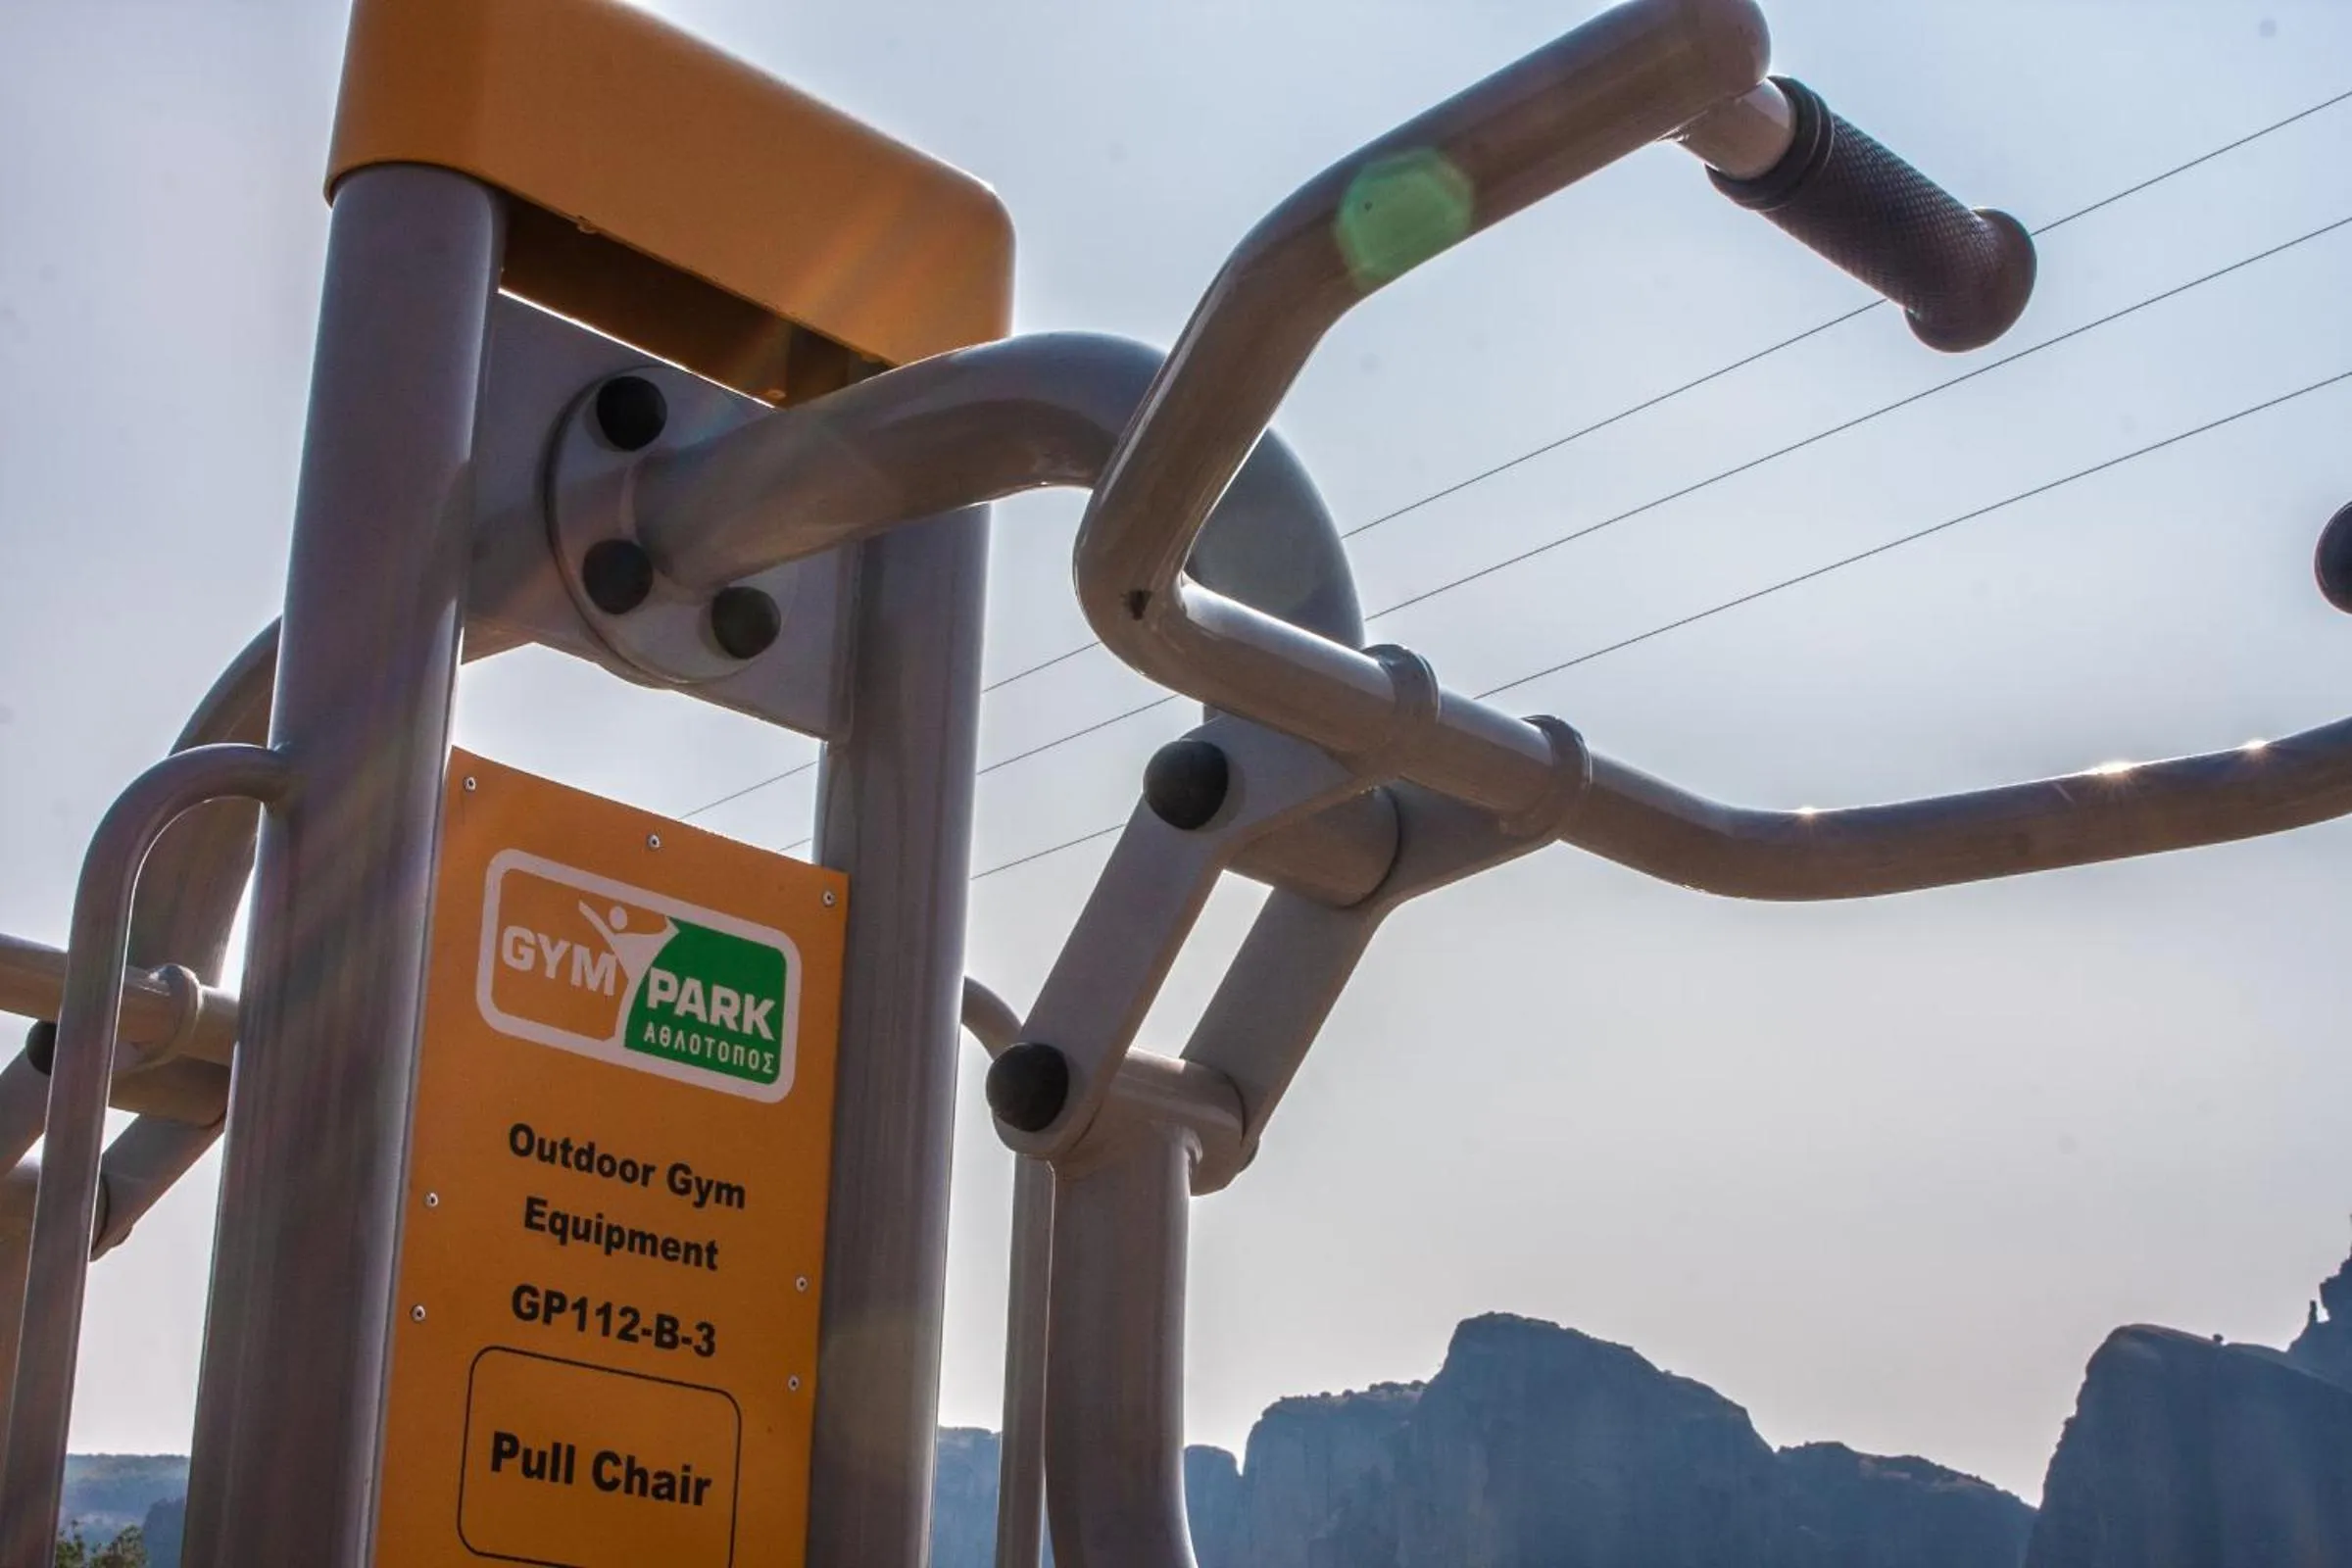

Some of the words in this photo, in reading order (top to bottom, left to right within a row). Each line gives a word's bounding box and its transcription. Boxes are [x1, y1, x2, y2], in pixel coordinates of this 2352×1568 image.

[502, 925, 617, 997] GYM
[647, 966, 775, 1041] PARK
[644, 1022, 774, 1074] ΑΘΛΟΤΟΠΟΣ
[509, 1123, 656, 1188] Outdoor
[666, 1162, 745, 1209] Gym
[523, 1196, 718, 1271] Equipment
[512, 1283, 715, 1357] GP112-B-3
[491, 1430, 575, 1485] Pull
[592, 1450, 711, 1506] Chair
